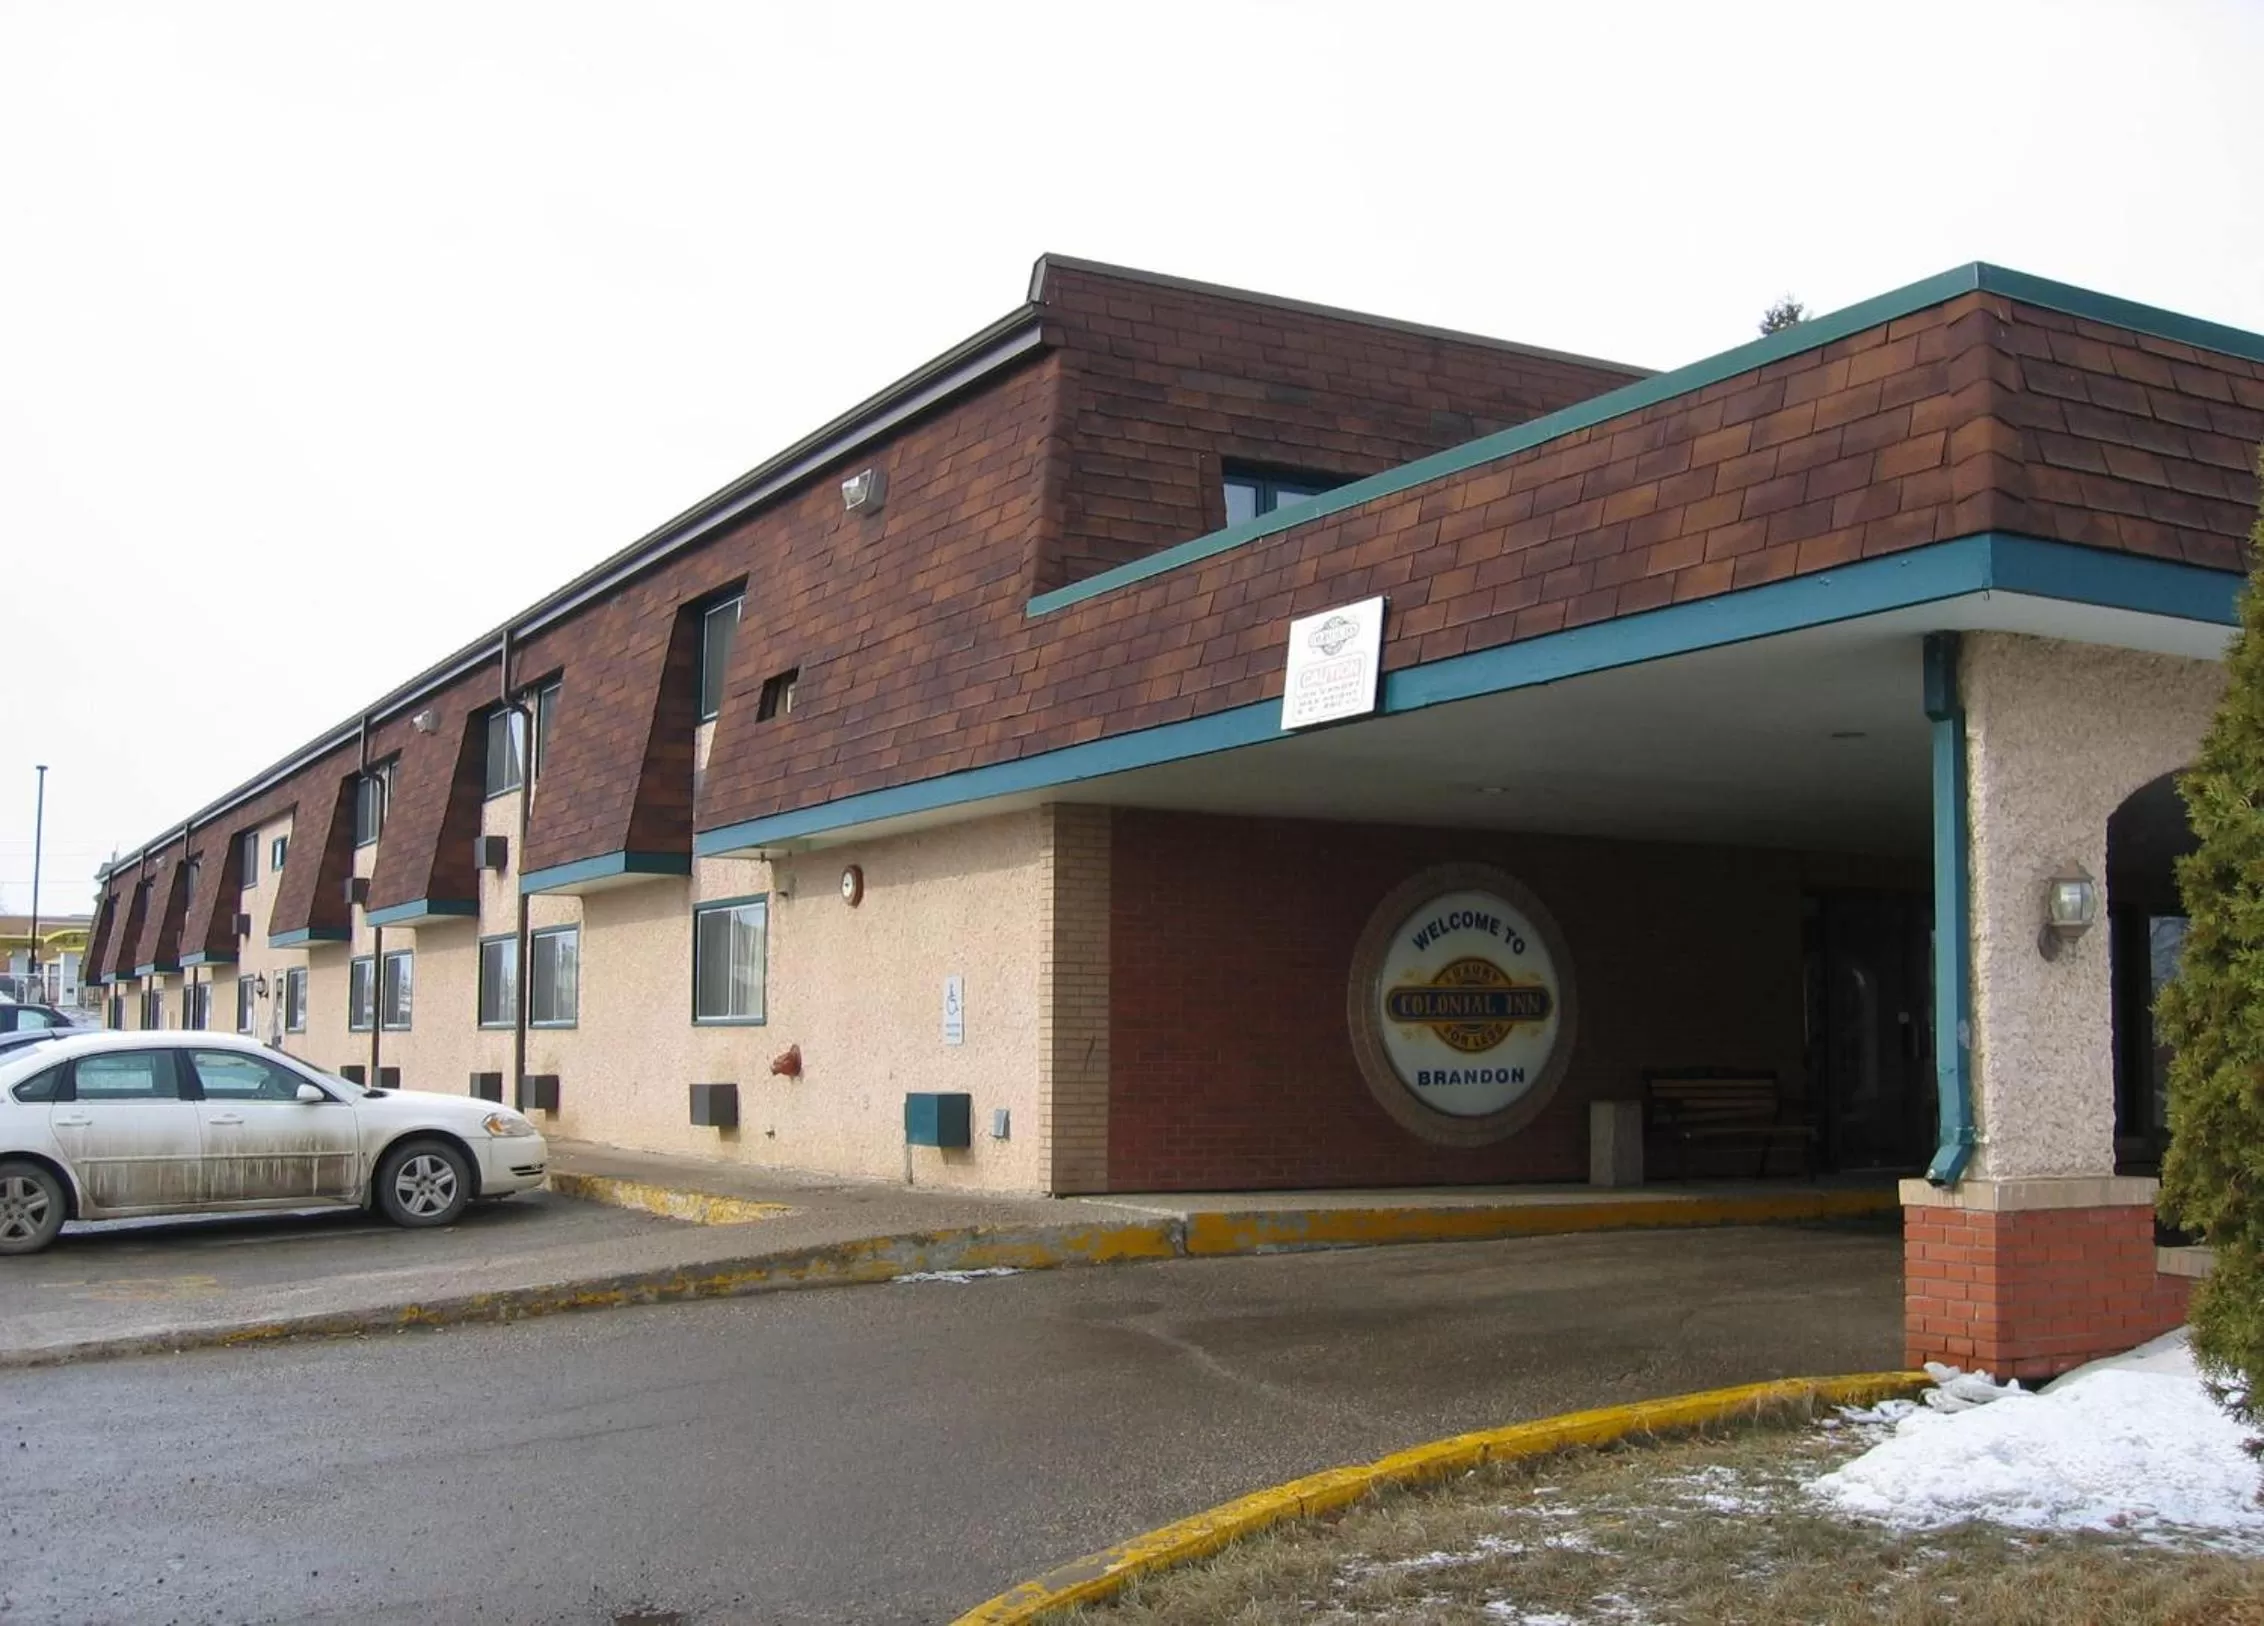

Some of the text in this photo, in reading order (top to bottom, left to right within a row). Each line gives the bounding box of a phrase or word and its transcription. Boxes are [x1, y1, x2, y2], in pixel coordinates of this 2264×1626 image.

[1412, 911, 1526, 956] WELCOME TO
[1401, 993, 1541, 1016] COLONIAL INN
[1417, 1067, 1525, 1086] BRANDON
